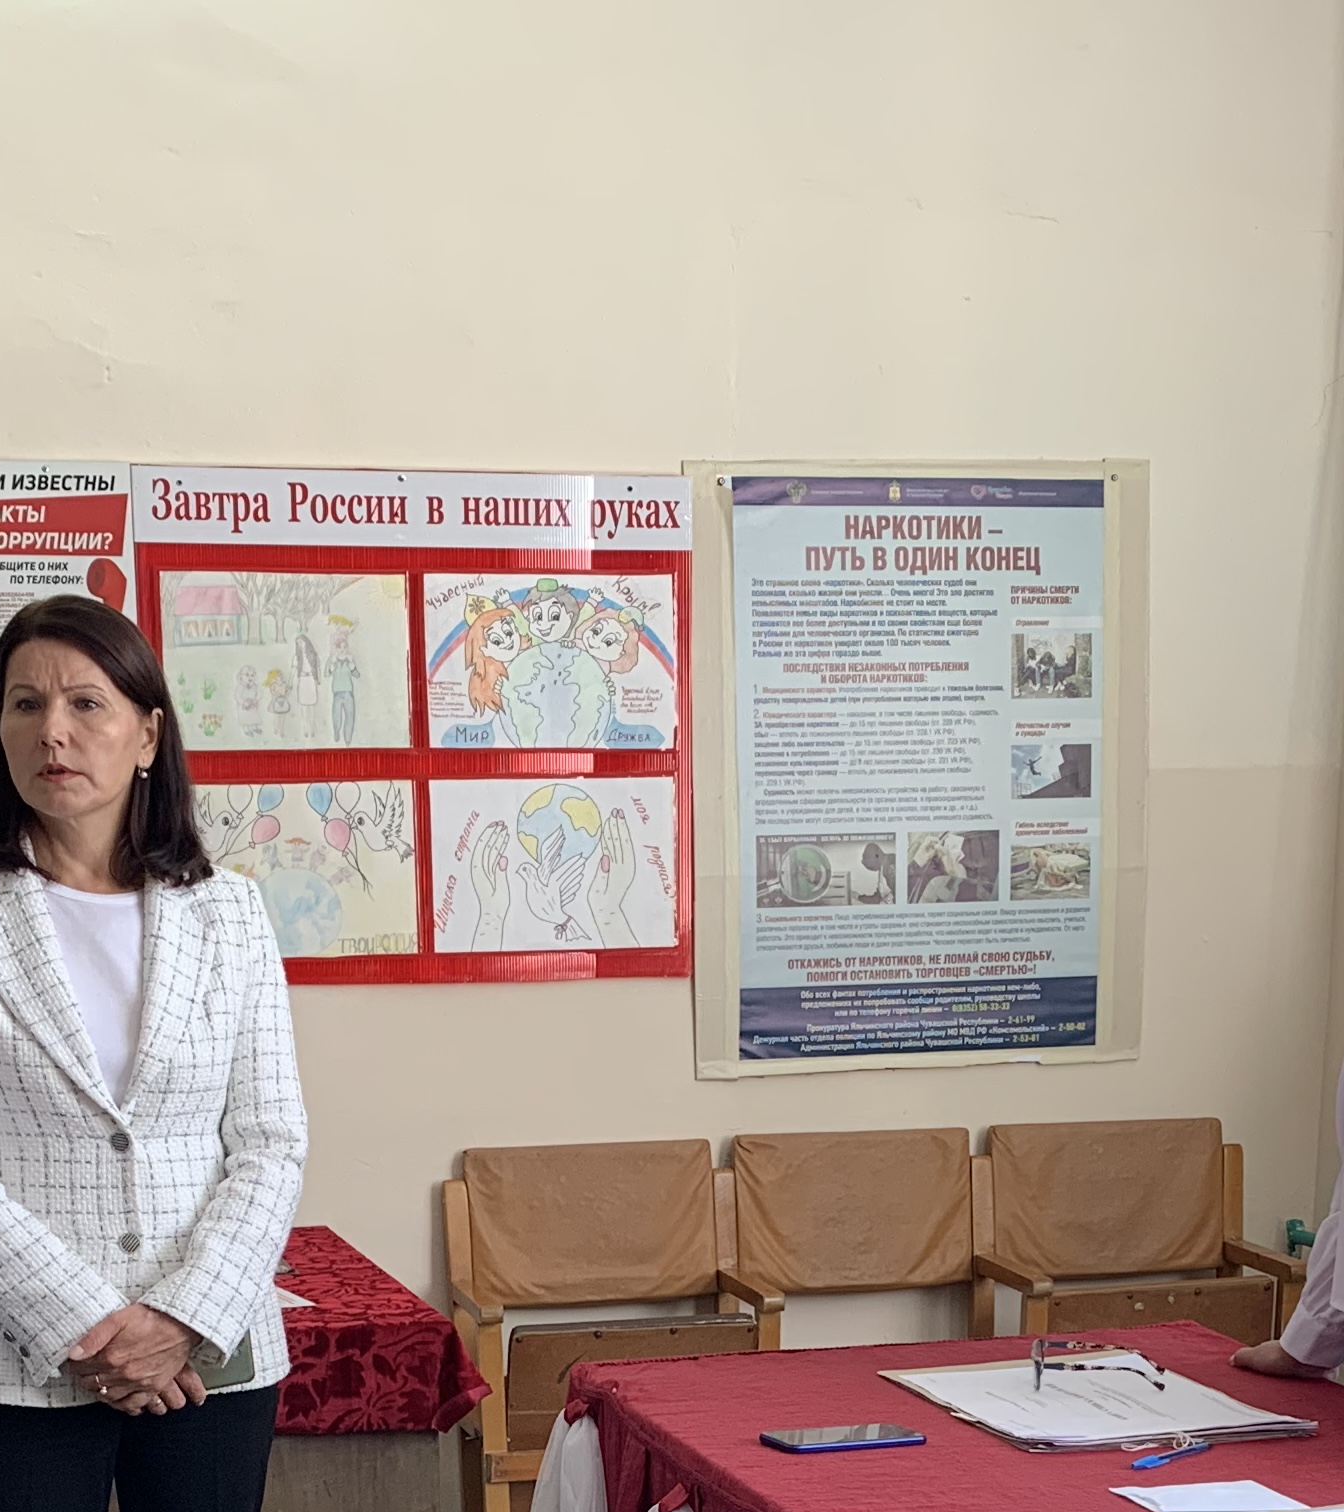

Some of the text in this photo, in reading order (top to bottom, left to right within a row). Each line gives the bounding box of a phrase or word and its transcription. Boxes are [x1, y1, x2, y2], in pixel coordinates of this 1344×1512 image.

[12, 475, 116, 491] ИЗВЕСТНЫ
[152, 477, 680, 539] Завтра России в наших руках
[845, 514, 982, 540] НАРКОТИКИ
[39, 562, 45, 571] О
[47, 562, 68, 571] НИХ
[805, 546, 1040, 576] ПУТЬ В ОДИН КОНЕЦ
[10, 575, 84, 585] ПО ТЕЛЕФОНУ:
[1010, 585, 1080, 594] ПРИЧИНЫ СМЕРТИ
[1010, 596, 1020, 604] ОТ
[783, 663, 846, 674] ПОСЛЕДСТВИЯ
[909, 662, 970, 672] ПОТРЕБЛЕНИЯ
[828, 674, 868, 684] ОБОРОТА
[788, 950, 1055, 970] ОТКАЖИСЬ ОТ НАРКОТИКОВ, НЕ ЛОМАЙ СВОЮ СУДЬБУ,
[806, 964, 1036, 982] ПОМОГИ ОСТАНОВИТЬ ТОРГОВЦЕВ «СМЕРТЬЮ»!
